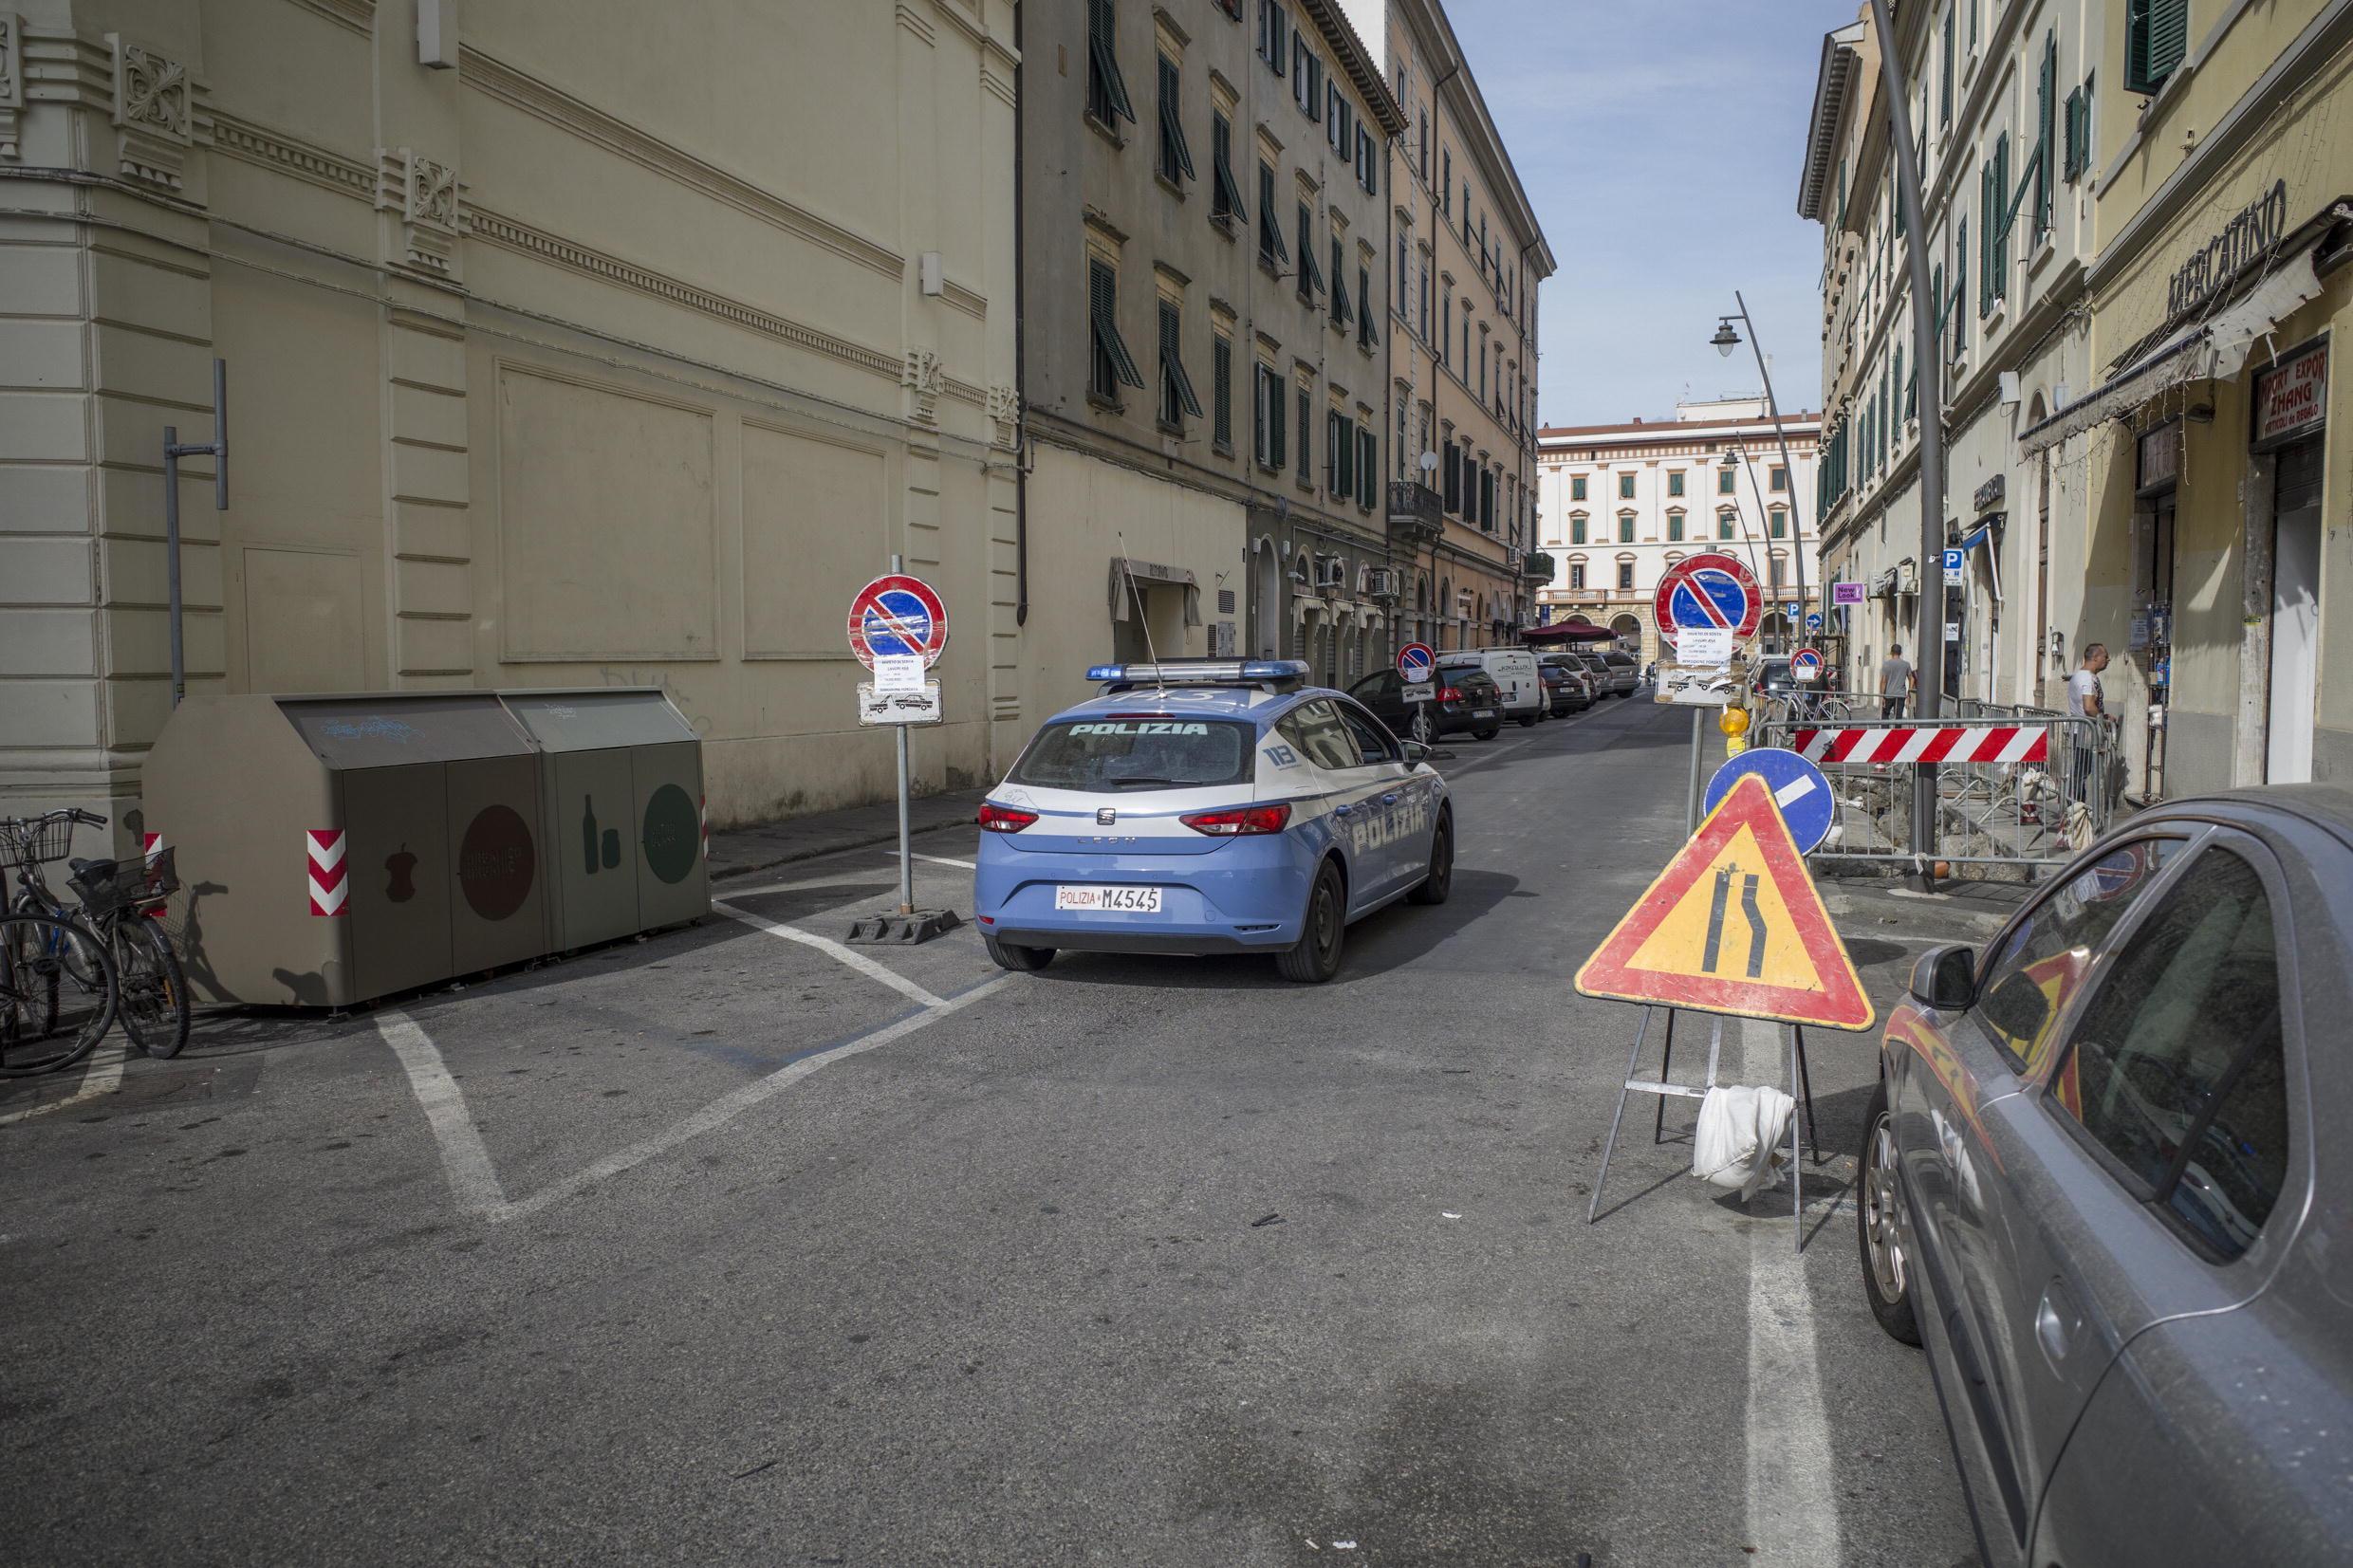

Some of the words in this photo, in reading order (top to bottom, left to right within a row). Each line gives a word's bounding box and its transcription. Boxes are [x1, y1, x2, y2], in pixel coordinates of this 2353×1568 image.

[2167, 178, 2287, 321] MERCATINO
[2270, 381, 2312, 416] ZHANG
[2296, 404, 2318, 422] REGALO
[1946, 553, 1958, 567] P
[1789, 604, 1799, 616] P
[1069, 723, 1209, 736] POLIZIA
[1262, 745, 1297, 766] 113
[1352, 804, 1425, 858] POLIZIA
[1060, 891, 1096, 904] POLIZIA
[1102, 889, 1158, 910] M4545
